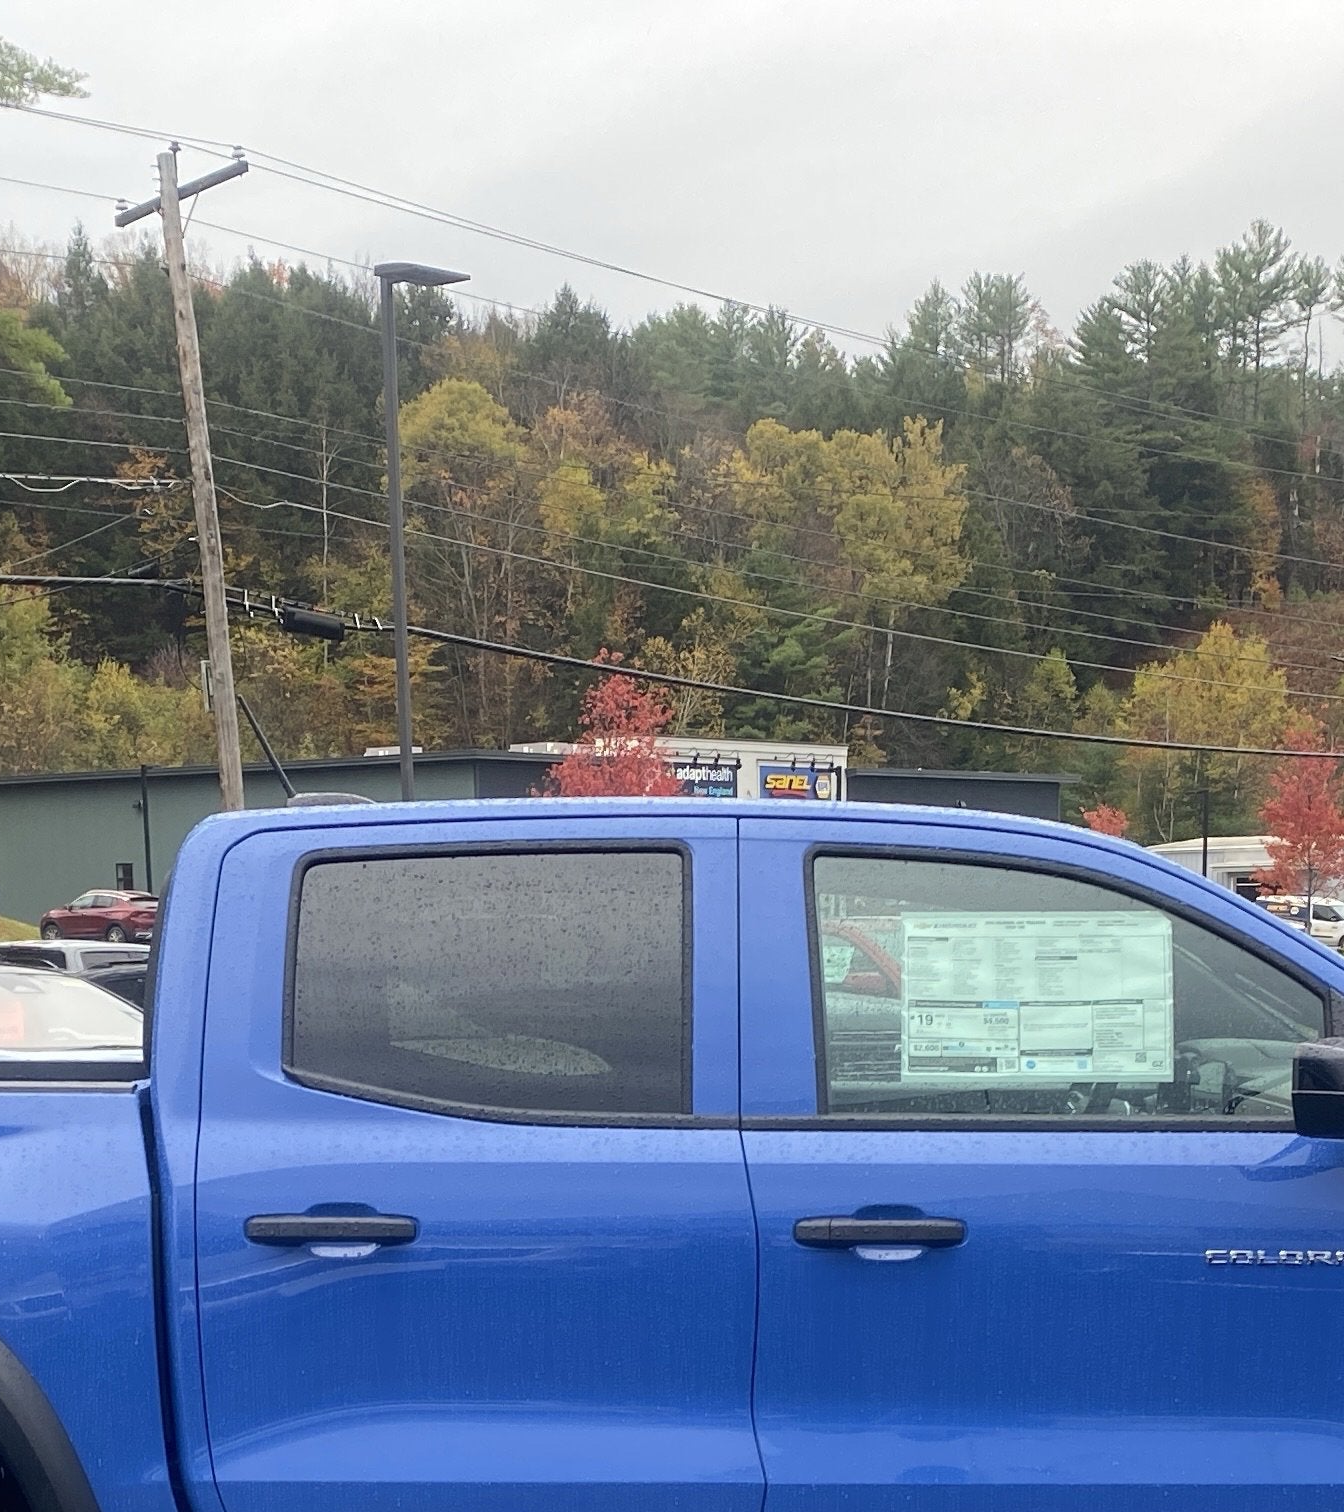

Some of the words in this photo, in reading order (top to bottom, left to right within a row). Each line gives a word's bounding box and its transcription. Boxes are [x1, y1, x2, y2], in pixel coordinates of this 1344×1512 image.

[676, 766, 733, 784] adapthealth
[693, 785, 707, 795] New
[708, 786, 733, 797] England
[917, 1014, 934, 1026] 19
